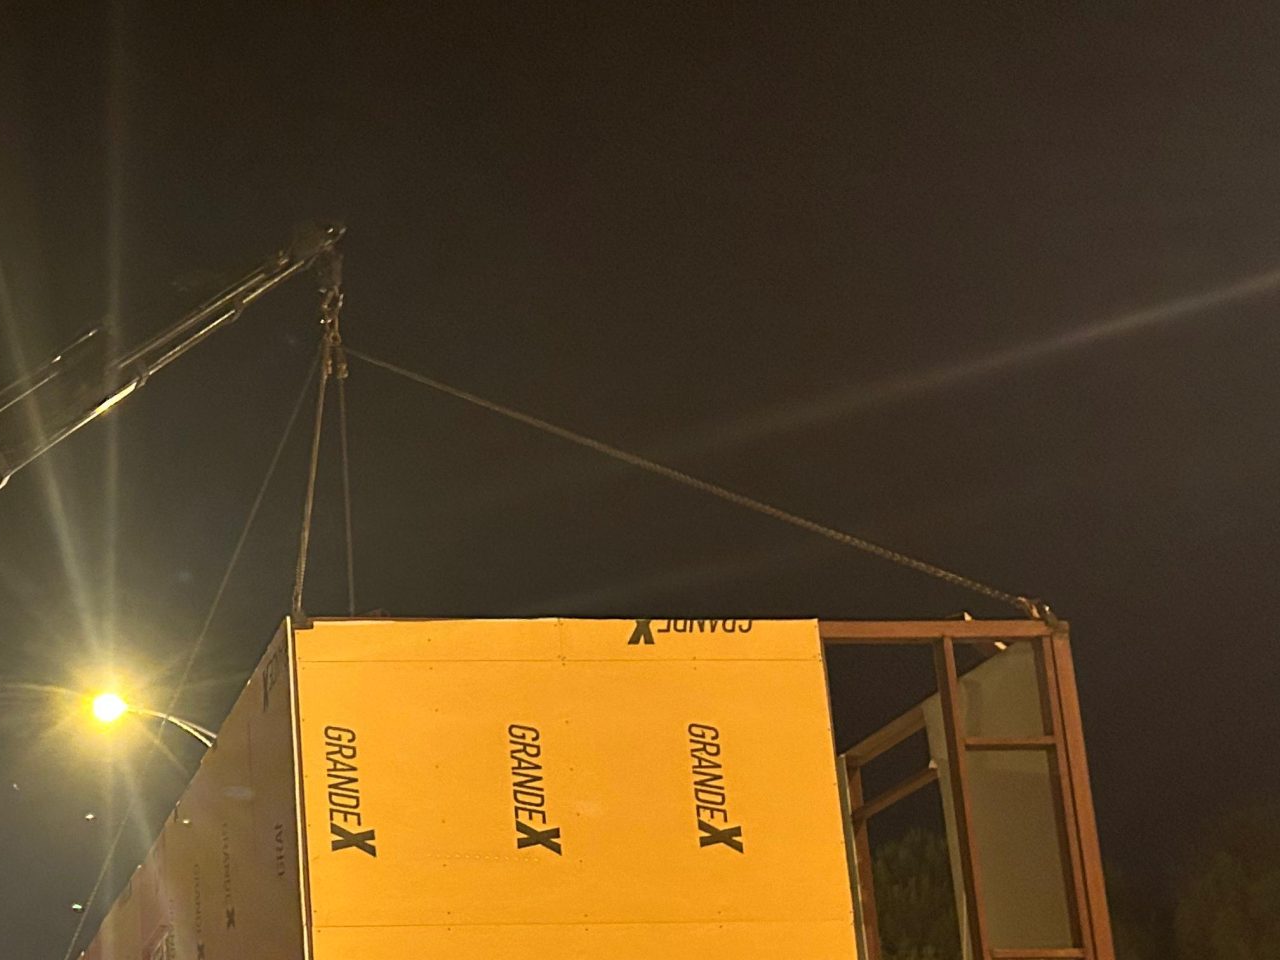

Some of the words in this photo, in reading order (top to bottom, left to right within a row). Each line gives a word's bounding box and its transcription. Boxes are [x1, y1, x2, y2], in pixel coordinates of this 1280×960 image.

[325, 726, 377, 858] GRANDEX
[508, 724, 562, 856] GRANDEX
[687, 723, 744, 854] GRANDEX
